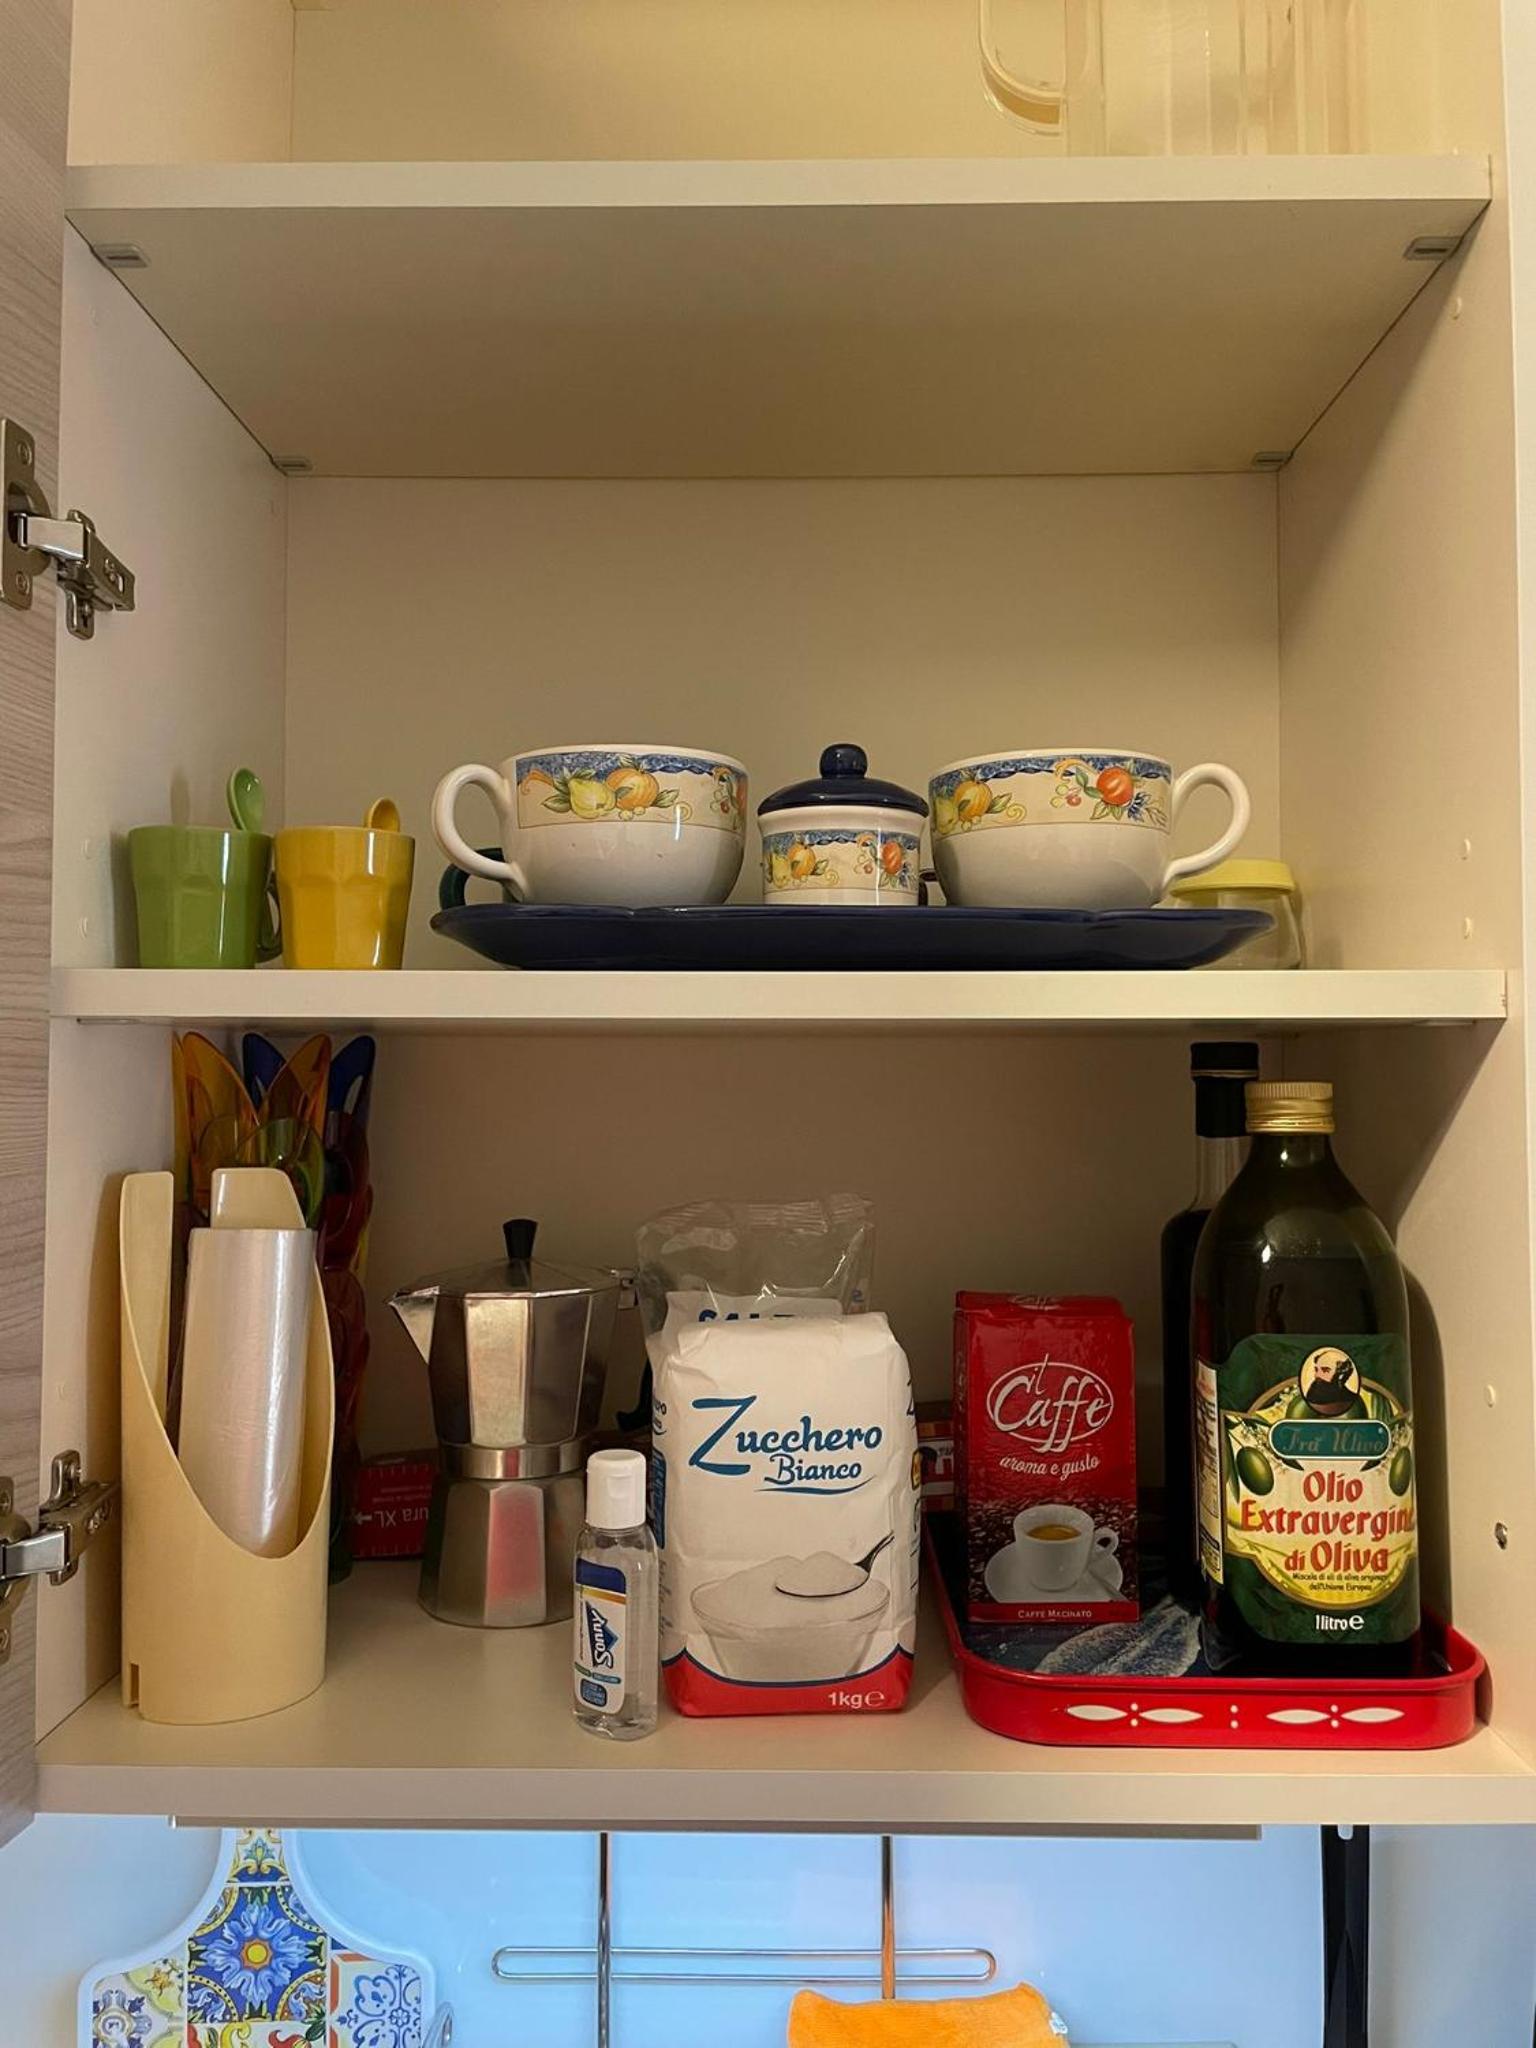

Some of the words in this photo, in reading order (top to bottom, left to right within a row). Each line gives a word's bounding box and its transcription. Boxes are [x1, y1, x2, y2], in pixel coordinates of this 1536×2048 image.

[689, 1395, 882, 1476] Zucchero
[764, 1453, 862, 1485] Bianco
[1000, 1456, 1048, 1475] aroma
[1050, 1463, 1060, 1474] e
[1061, 1453, 1100, 1481] gusto
[1303, 1471, 1363, 1503] Olio
[1284, 1550, 1306, 1572] di
[1310, 1541, 1389, 1573] Oliva
[590, 1608, 614, 1670] Sonny
